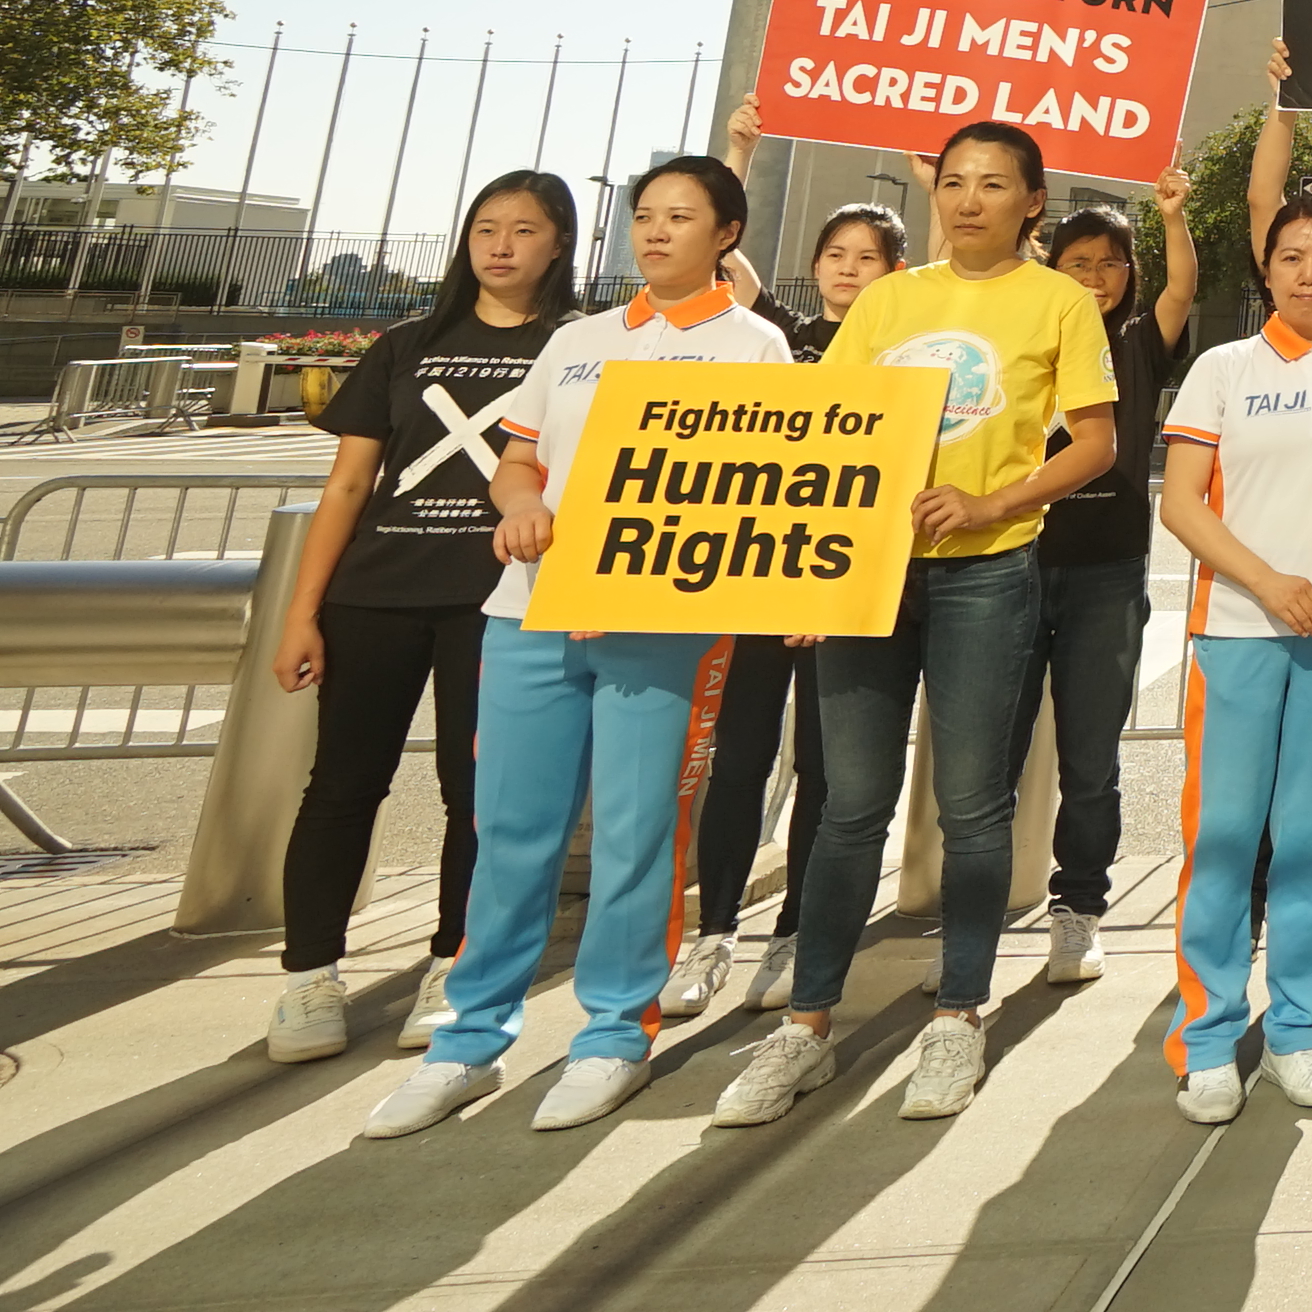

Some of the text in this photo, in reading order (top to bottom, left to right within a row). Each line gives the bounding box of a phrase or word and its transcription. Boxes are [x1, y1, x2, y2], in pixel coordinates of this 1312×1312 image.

[900, 8, 947, 48] JI
[957, 13, 1132, 73] MEN'S
[783, 57, 1150, 139] SACRED LAND
[558, 361, 601, 386] TAI
[1245, 390, 1307, 416] TAI JI
[639, 400, 883, 441] Fighting for
[604, 448, 880, 508] Human
[596, 515, 853, 592] Rights
[678, 650, 728, 797] TAI JI MEN
